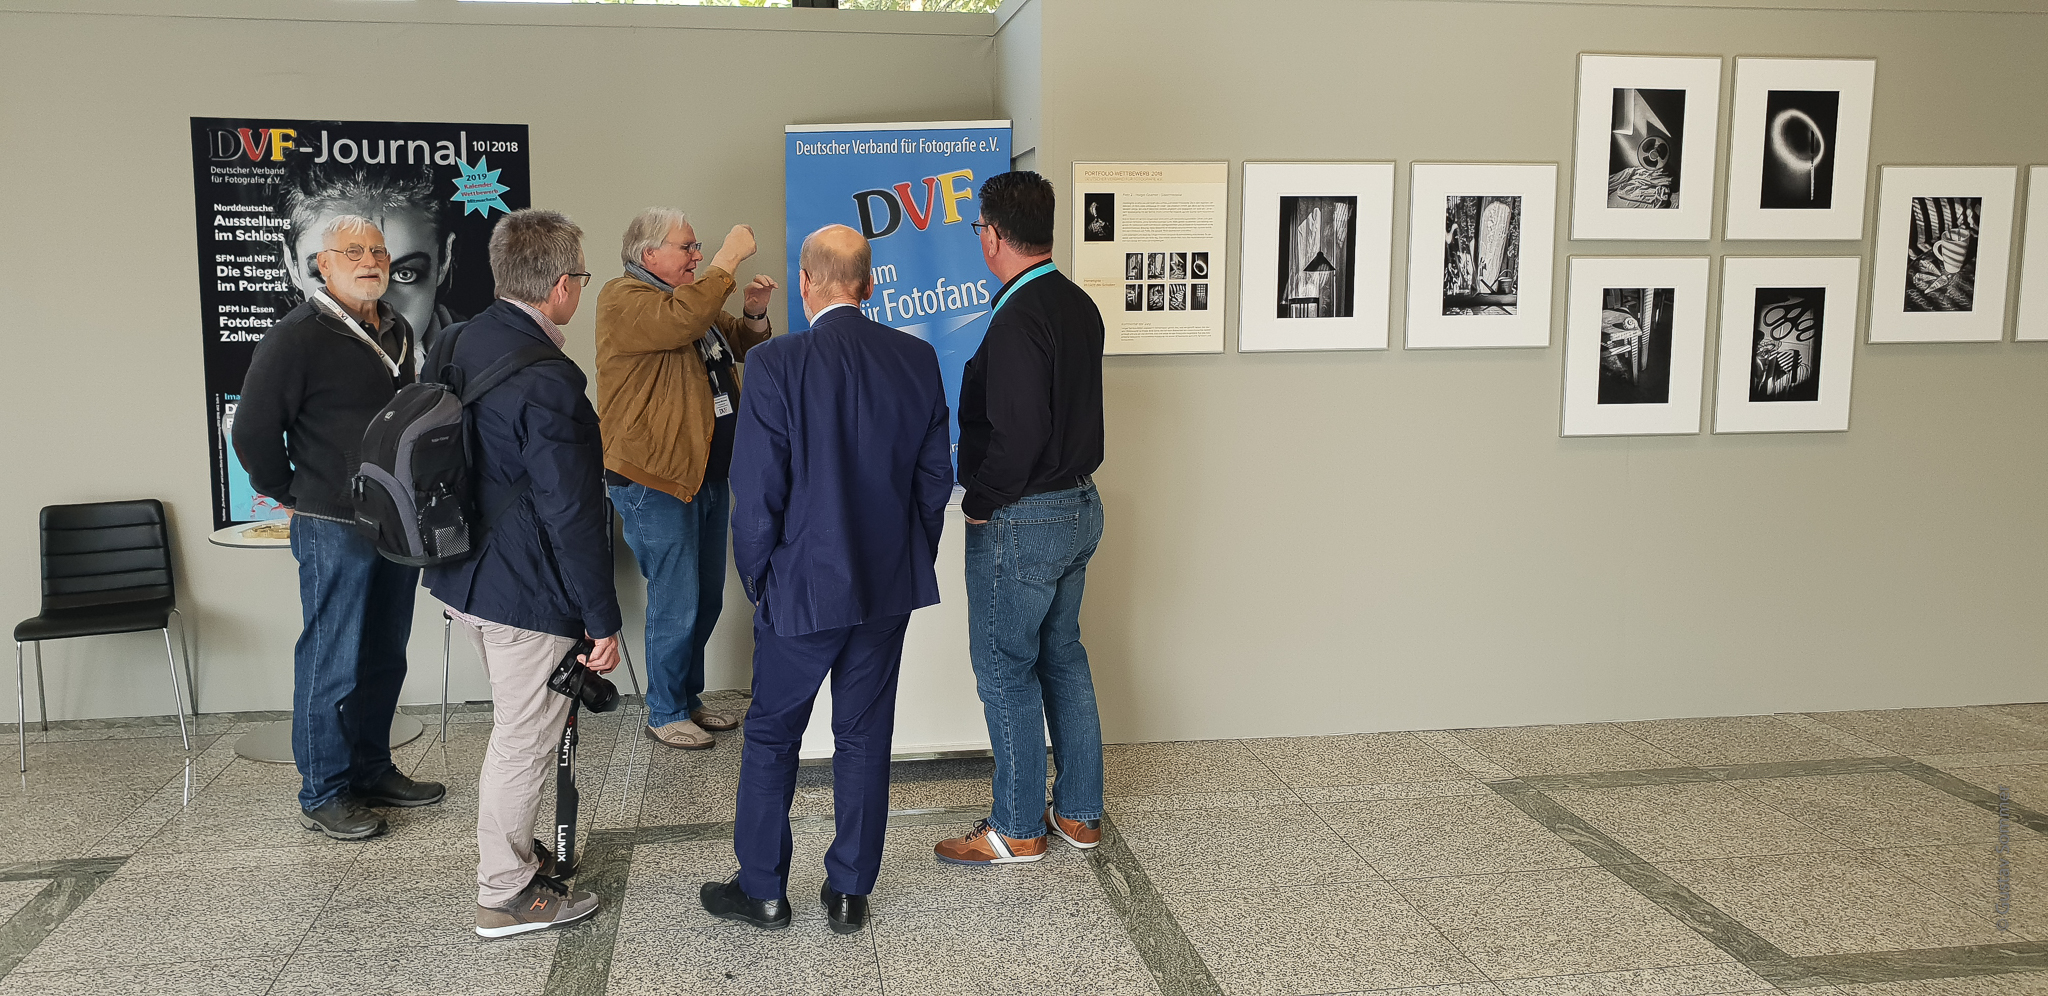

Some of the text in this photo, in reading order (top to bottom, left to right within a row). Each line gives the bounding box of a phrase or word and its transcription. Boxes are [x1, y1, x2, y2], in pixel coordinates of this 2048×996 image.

[796, 136, 1000, 156] Deutscher Verband für Fotografie e.V.
[210, 166, 285, 175] Deutscher Verband
[211, 175, 223, 183] für
[224, 175, 266, 185] Fotografie
[466, 173, 488, 182] 2019
[213, 203, 274, 212] Norddeutsche
[852, 168, 974, 240] DVF
[213, 214, 291, 230] Ausstellung
[215, 229, 285, 241] im Schloss
[215, 254, 275, 263] SFM und NFM
[216, 265, 286, 280] Die Sieger
[217, 280, 289, 292] im Porträt
[882, 277, 990, 323] Fotofans
[218, 305, 275, 313] DFM in Essen
[219, 316, 273, 328] Fotofest
[560, 726, 573, 767] LUMIX
[557, 824, 569, 862] LUMIX
